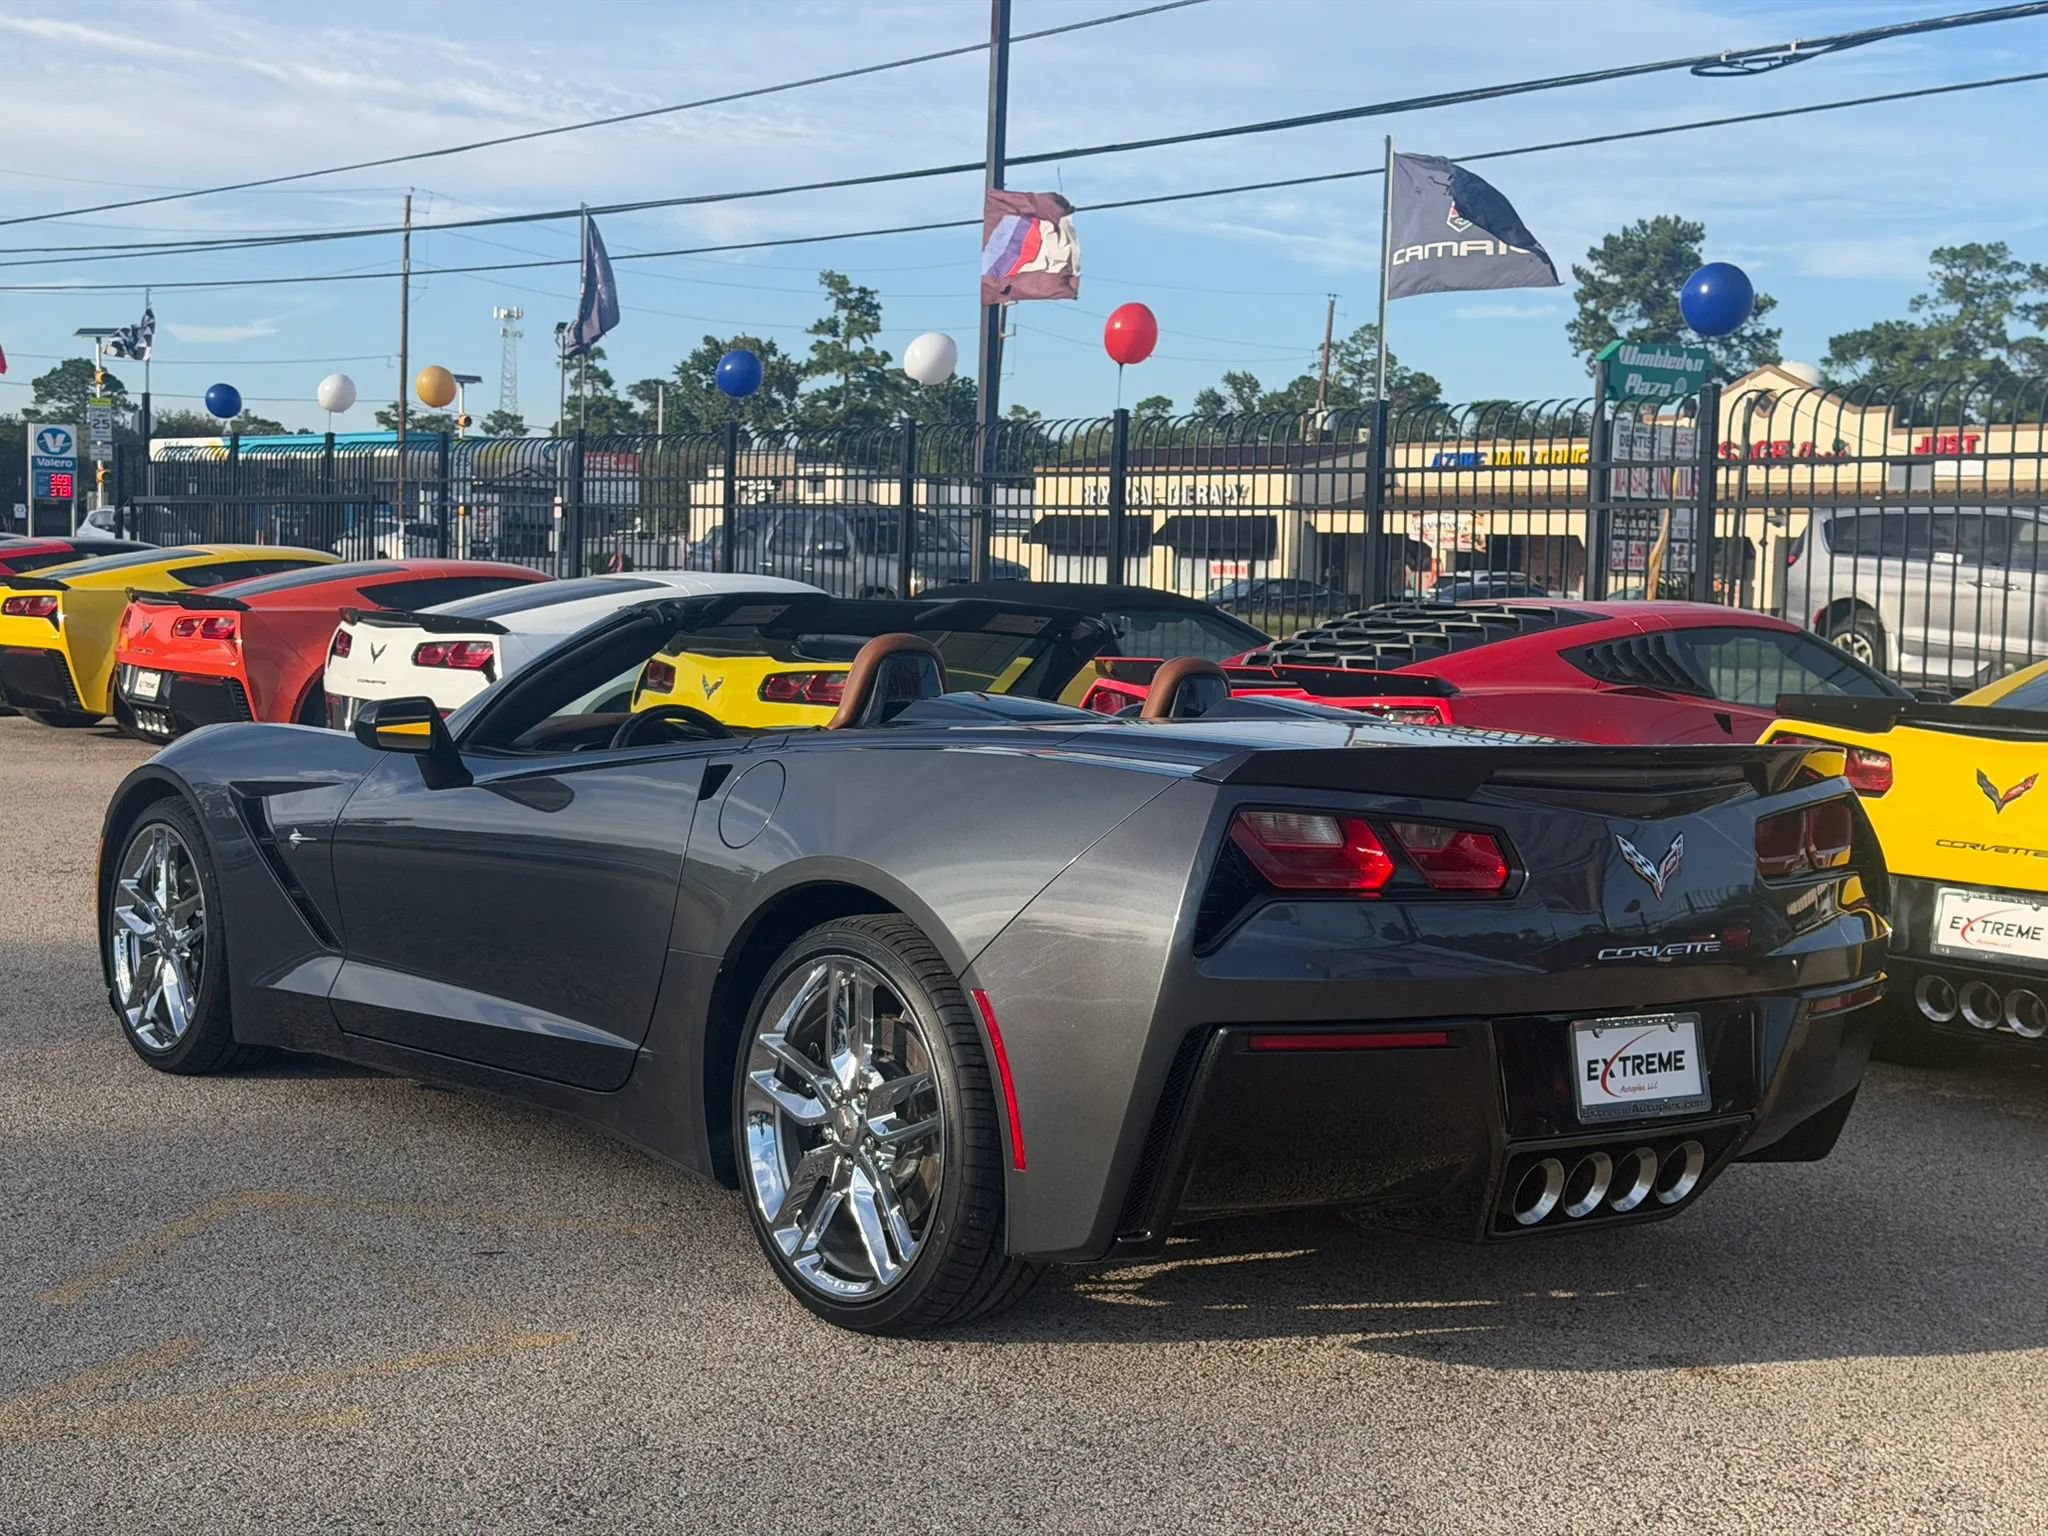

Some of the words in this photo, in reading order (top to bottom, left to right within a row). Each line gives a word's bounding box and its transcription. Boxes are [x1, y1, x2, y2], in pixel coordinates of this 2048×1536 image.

[1618, 345, 1705, 372] Wimbledon
[1625, 373, 1672, 397] Plaza
[93, 419, 110, 430] 25
[1914, 434, 1980, 455] JUST
[36, 457, 73, 468] Valero
[1949, 915, 2045, 941] EXTREME
[1598, 941, 1721, 960] CORVETTE
[1586, 1050, 1685, 1082] EXTREME
[1646, 1081, 1658, 1090] LLC
